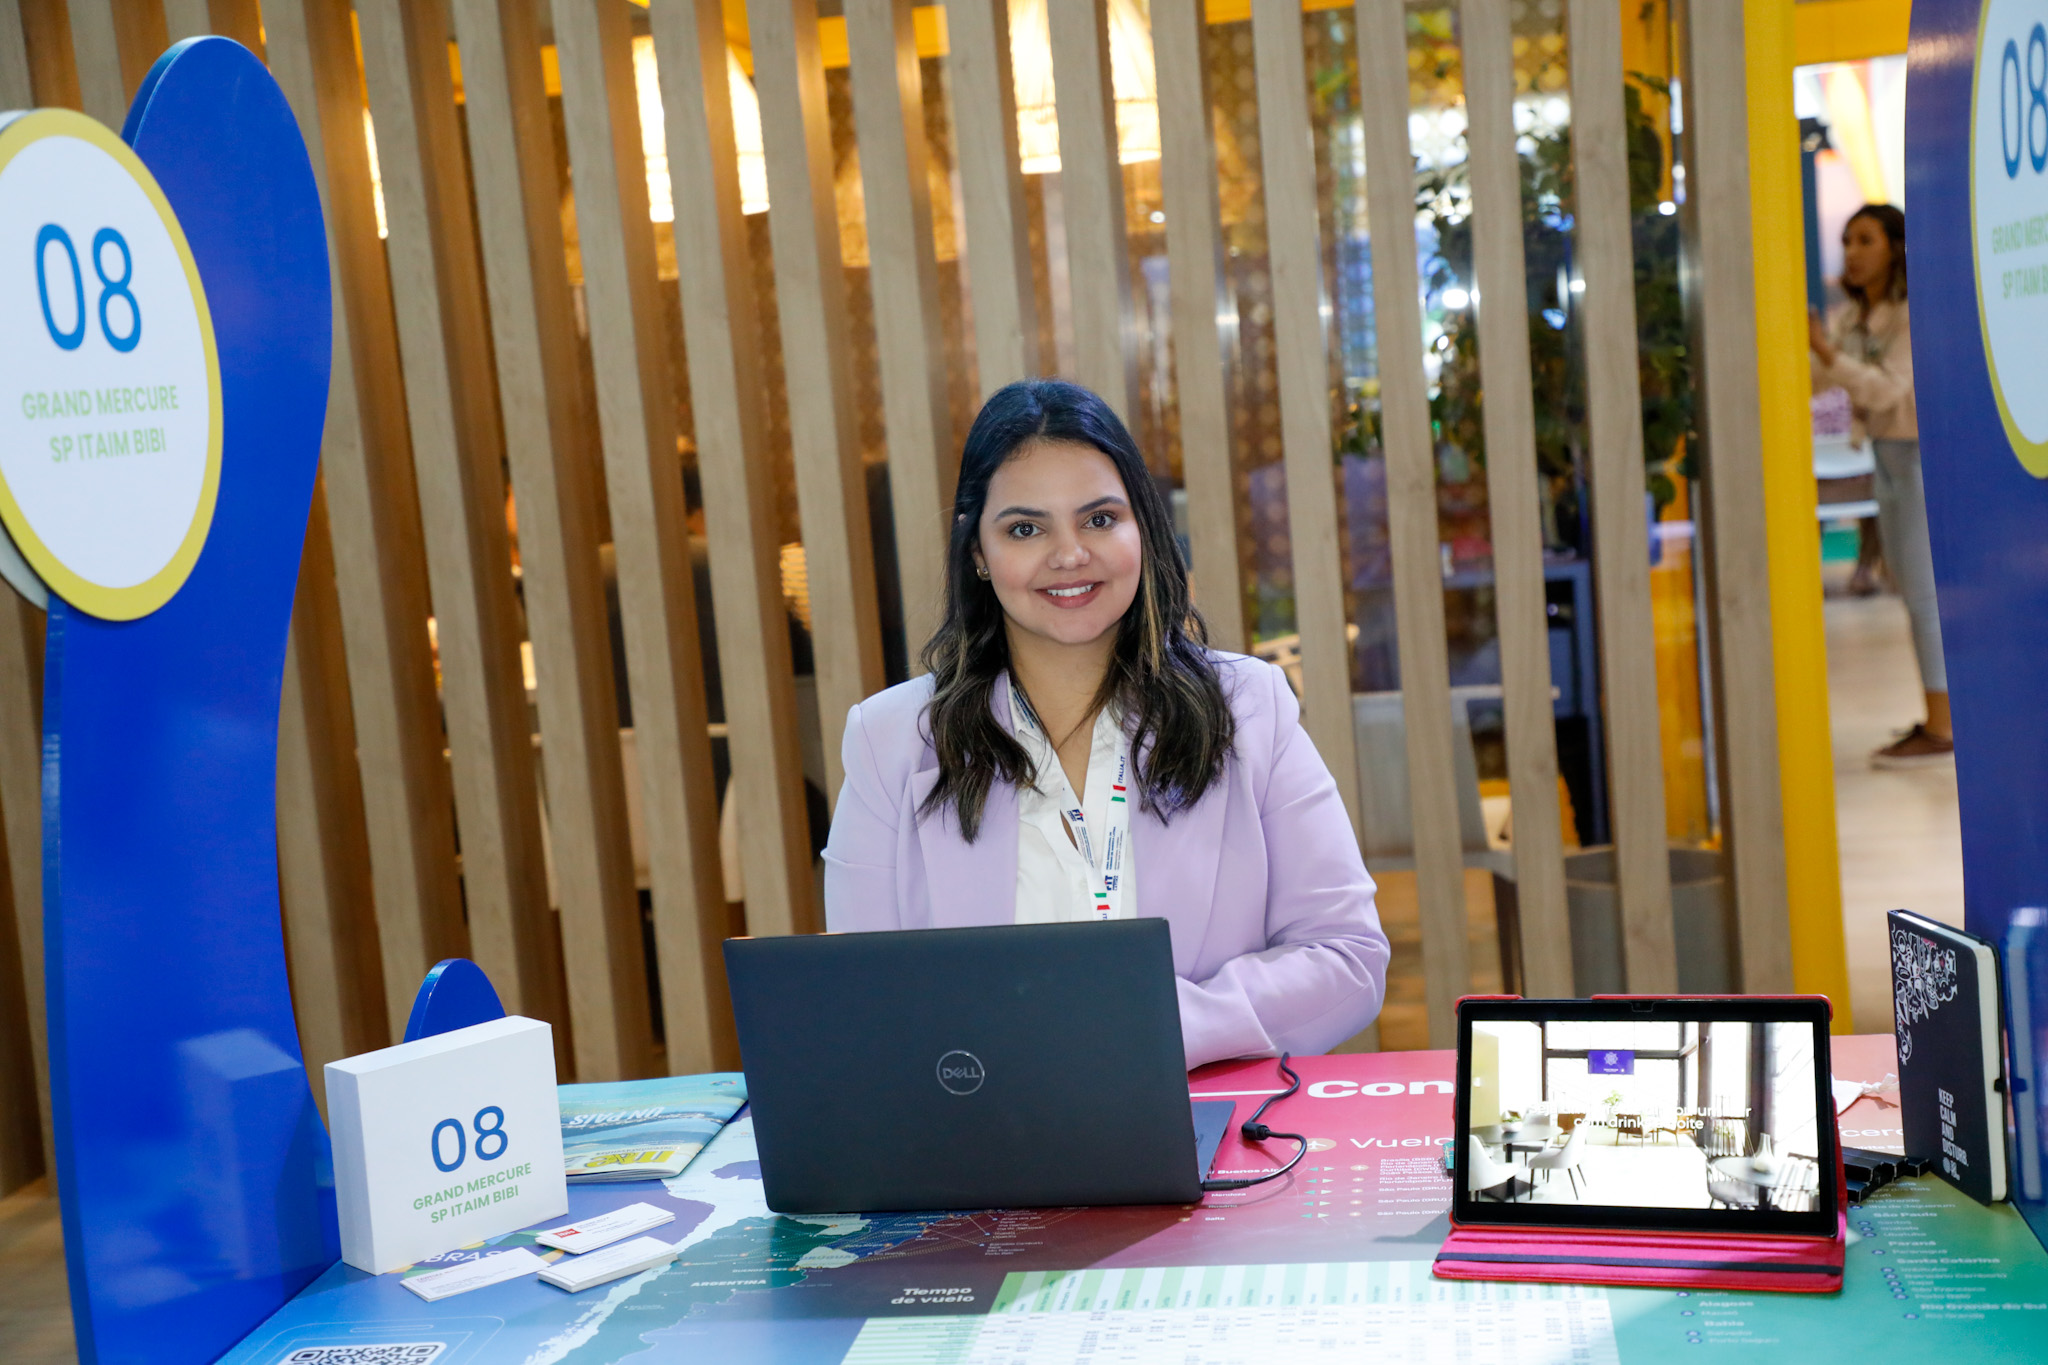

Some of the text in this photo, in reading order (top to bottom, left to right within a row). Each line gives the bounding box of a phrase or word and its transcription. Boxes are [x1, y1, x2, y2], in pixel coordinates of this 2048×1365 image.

[35, 223, 141, 353] 08
[22, 385, 179, 420] GRAND MERCURE
[50, 427, 167, 463] SP ITAIM BIBI
[942, 1067, 980, 1079] DELL
[1938, 1087, 1954, 1108] KEEP
[1939, 1104, 1957, 1127] CALM
[431, 1105, 508, 1173] 08
[1941, 1121, 1954, 1141] AND
[413, 1162, 532, 1210] GRAND MERCURE
[430, 1185, 519, 1223] SP ITAIM BIBI
[891, 1294, 975, 1305] de vuelo
[903, 1287, 972, 1298] Tiempo
